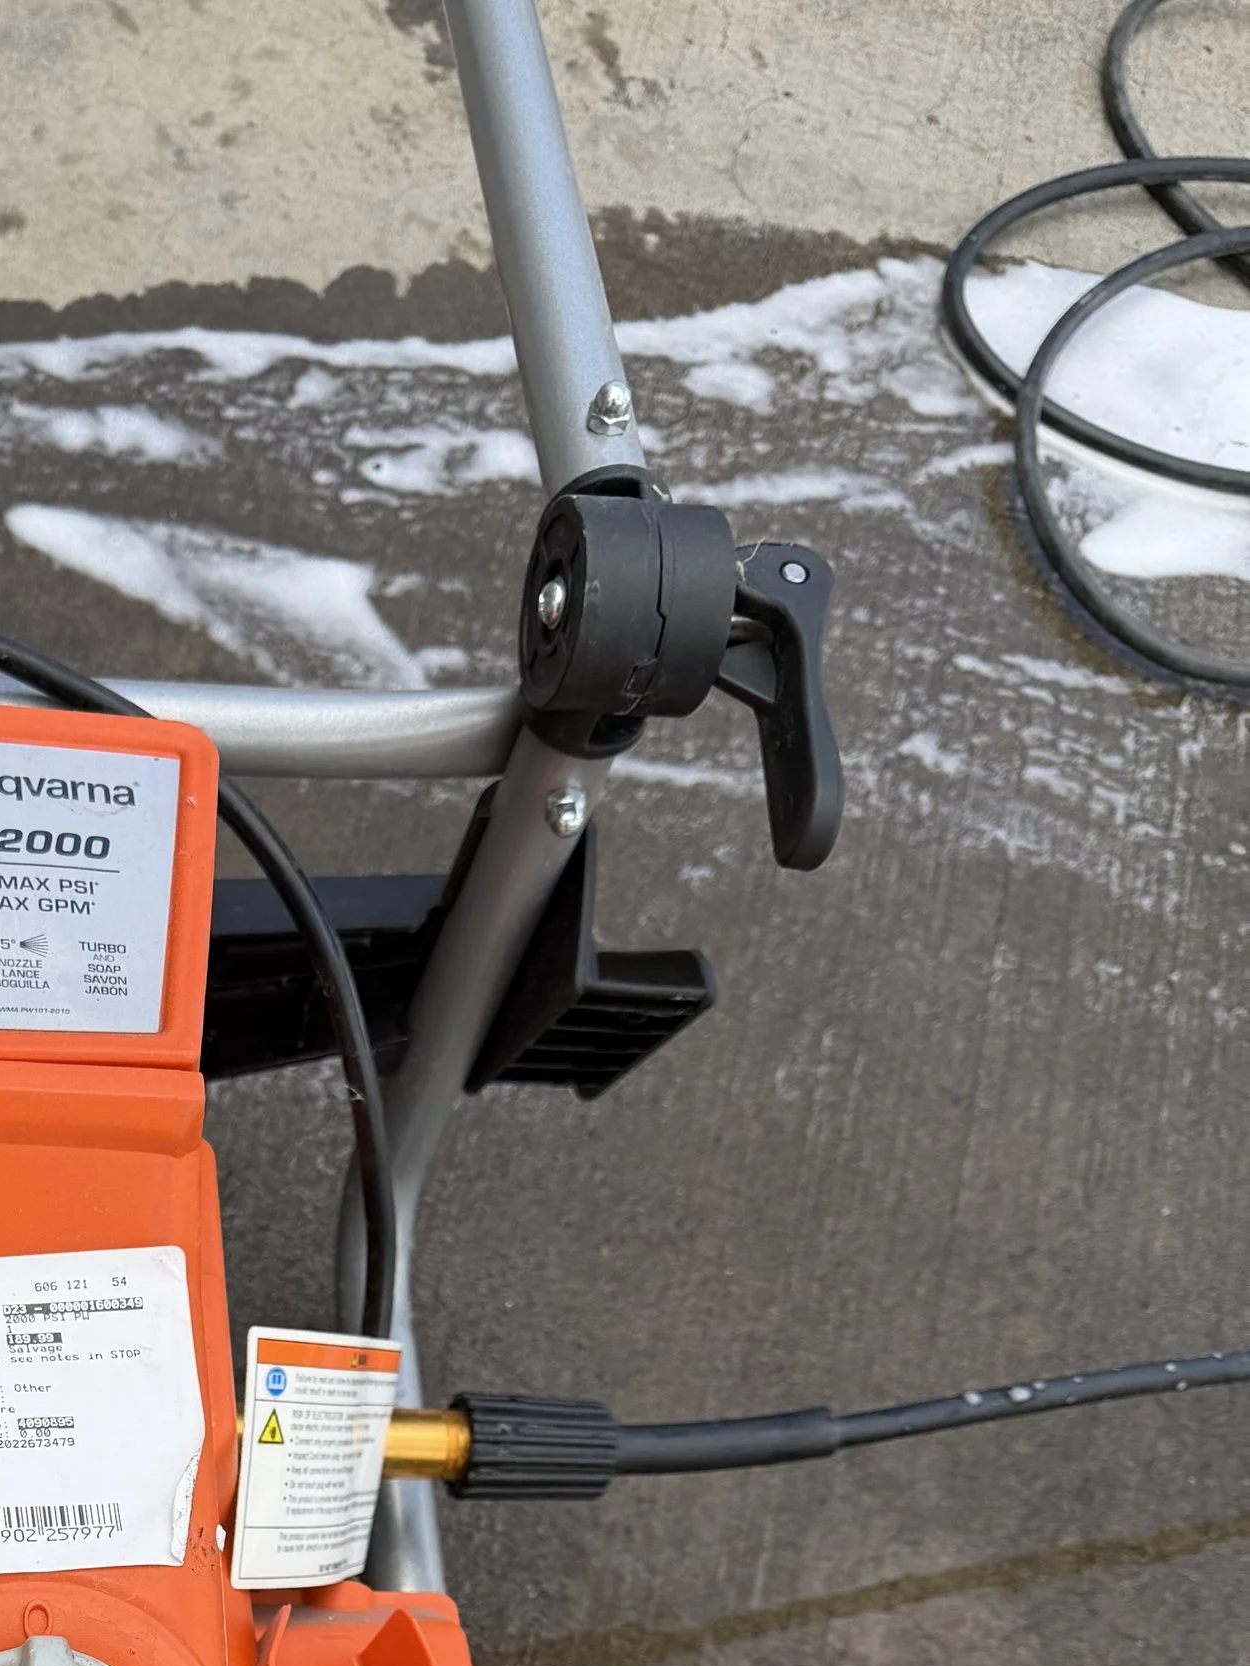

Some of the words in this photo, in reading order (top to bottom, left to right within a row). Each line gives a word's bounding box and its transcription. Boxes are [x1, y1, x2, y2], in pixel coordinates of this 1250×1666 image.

[78, 941, 127, 954] TURBO
[93, 954, 115, 962] AND
[88, 964, 121, 973] SOAP
[2, 969, 40, 978] LANCE
[84, 975, 127, 985] SAVON
[35, 1282, 58, 1292] 606
[67, 1280, 87, 1290] 121
[112, 1277, 126, 1286] 54
[4, 1305, 27, 1314] D23
[6, 1314, 35, 1323] 2000
[8, 1334, 54, 1344] 189.99
[9, 1345, 62, 1354] Salvage
[41, 1354, 79, 1362] notes
[90, 1352, 103, 1360] in
[111, 1350, 140, 1359] STOP
[14, 1384, 51, 1393] Other
[18, 1417, 74, 1429] 4090895
[20, 1429, 51, 1438] 0.00
